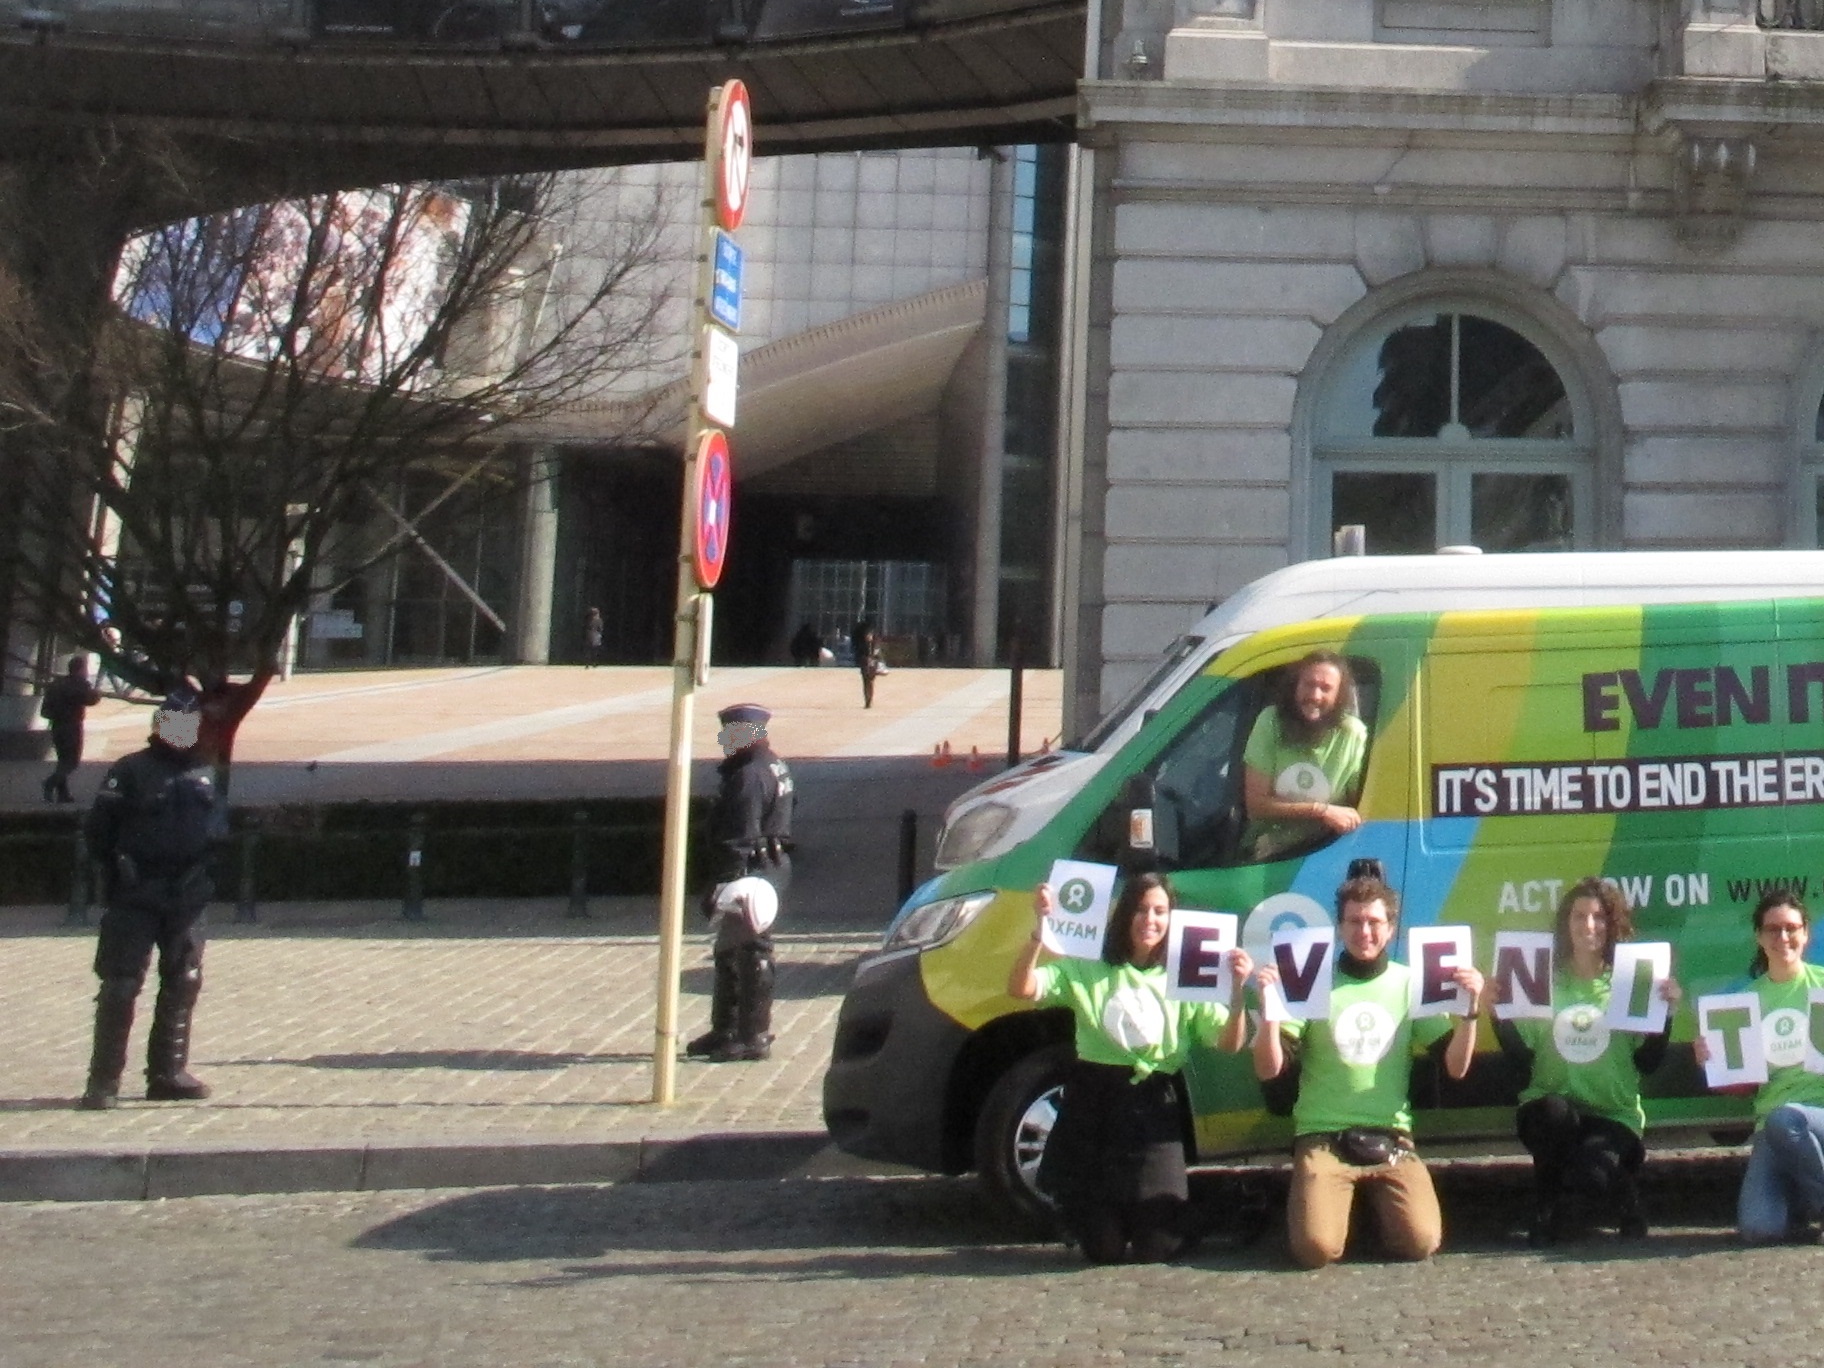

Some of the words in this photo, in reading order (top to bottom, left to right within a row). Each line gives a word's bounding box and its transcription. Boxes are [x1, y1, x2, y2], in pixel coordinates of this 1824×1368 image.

[1582, 665, 1771, 732] EVEN
[1438, 766, 1498, 814] IT'S
[1502, 766, 1583, 812] TIME
[1586, 764, 1632, 809] TO
[1638, 762, 1707, 807] END
[1710, 758, 1780, 804] THE
[1498, 878, 1563, 914] ACT
[1665, 873, 1710, 906] ON
[1177, 925, 1220, 988] E
[1273, 942, 1331, 1003] V
[1421, 940, 1458, 1005] E
[1496, 946, 1550, 1005] N
[1627, 958, 1654, 1018] I
[1707, 1006, 1752, 1070] T
